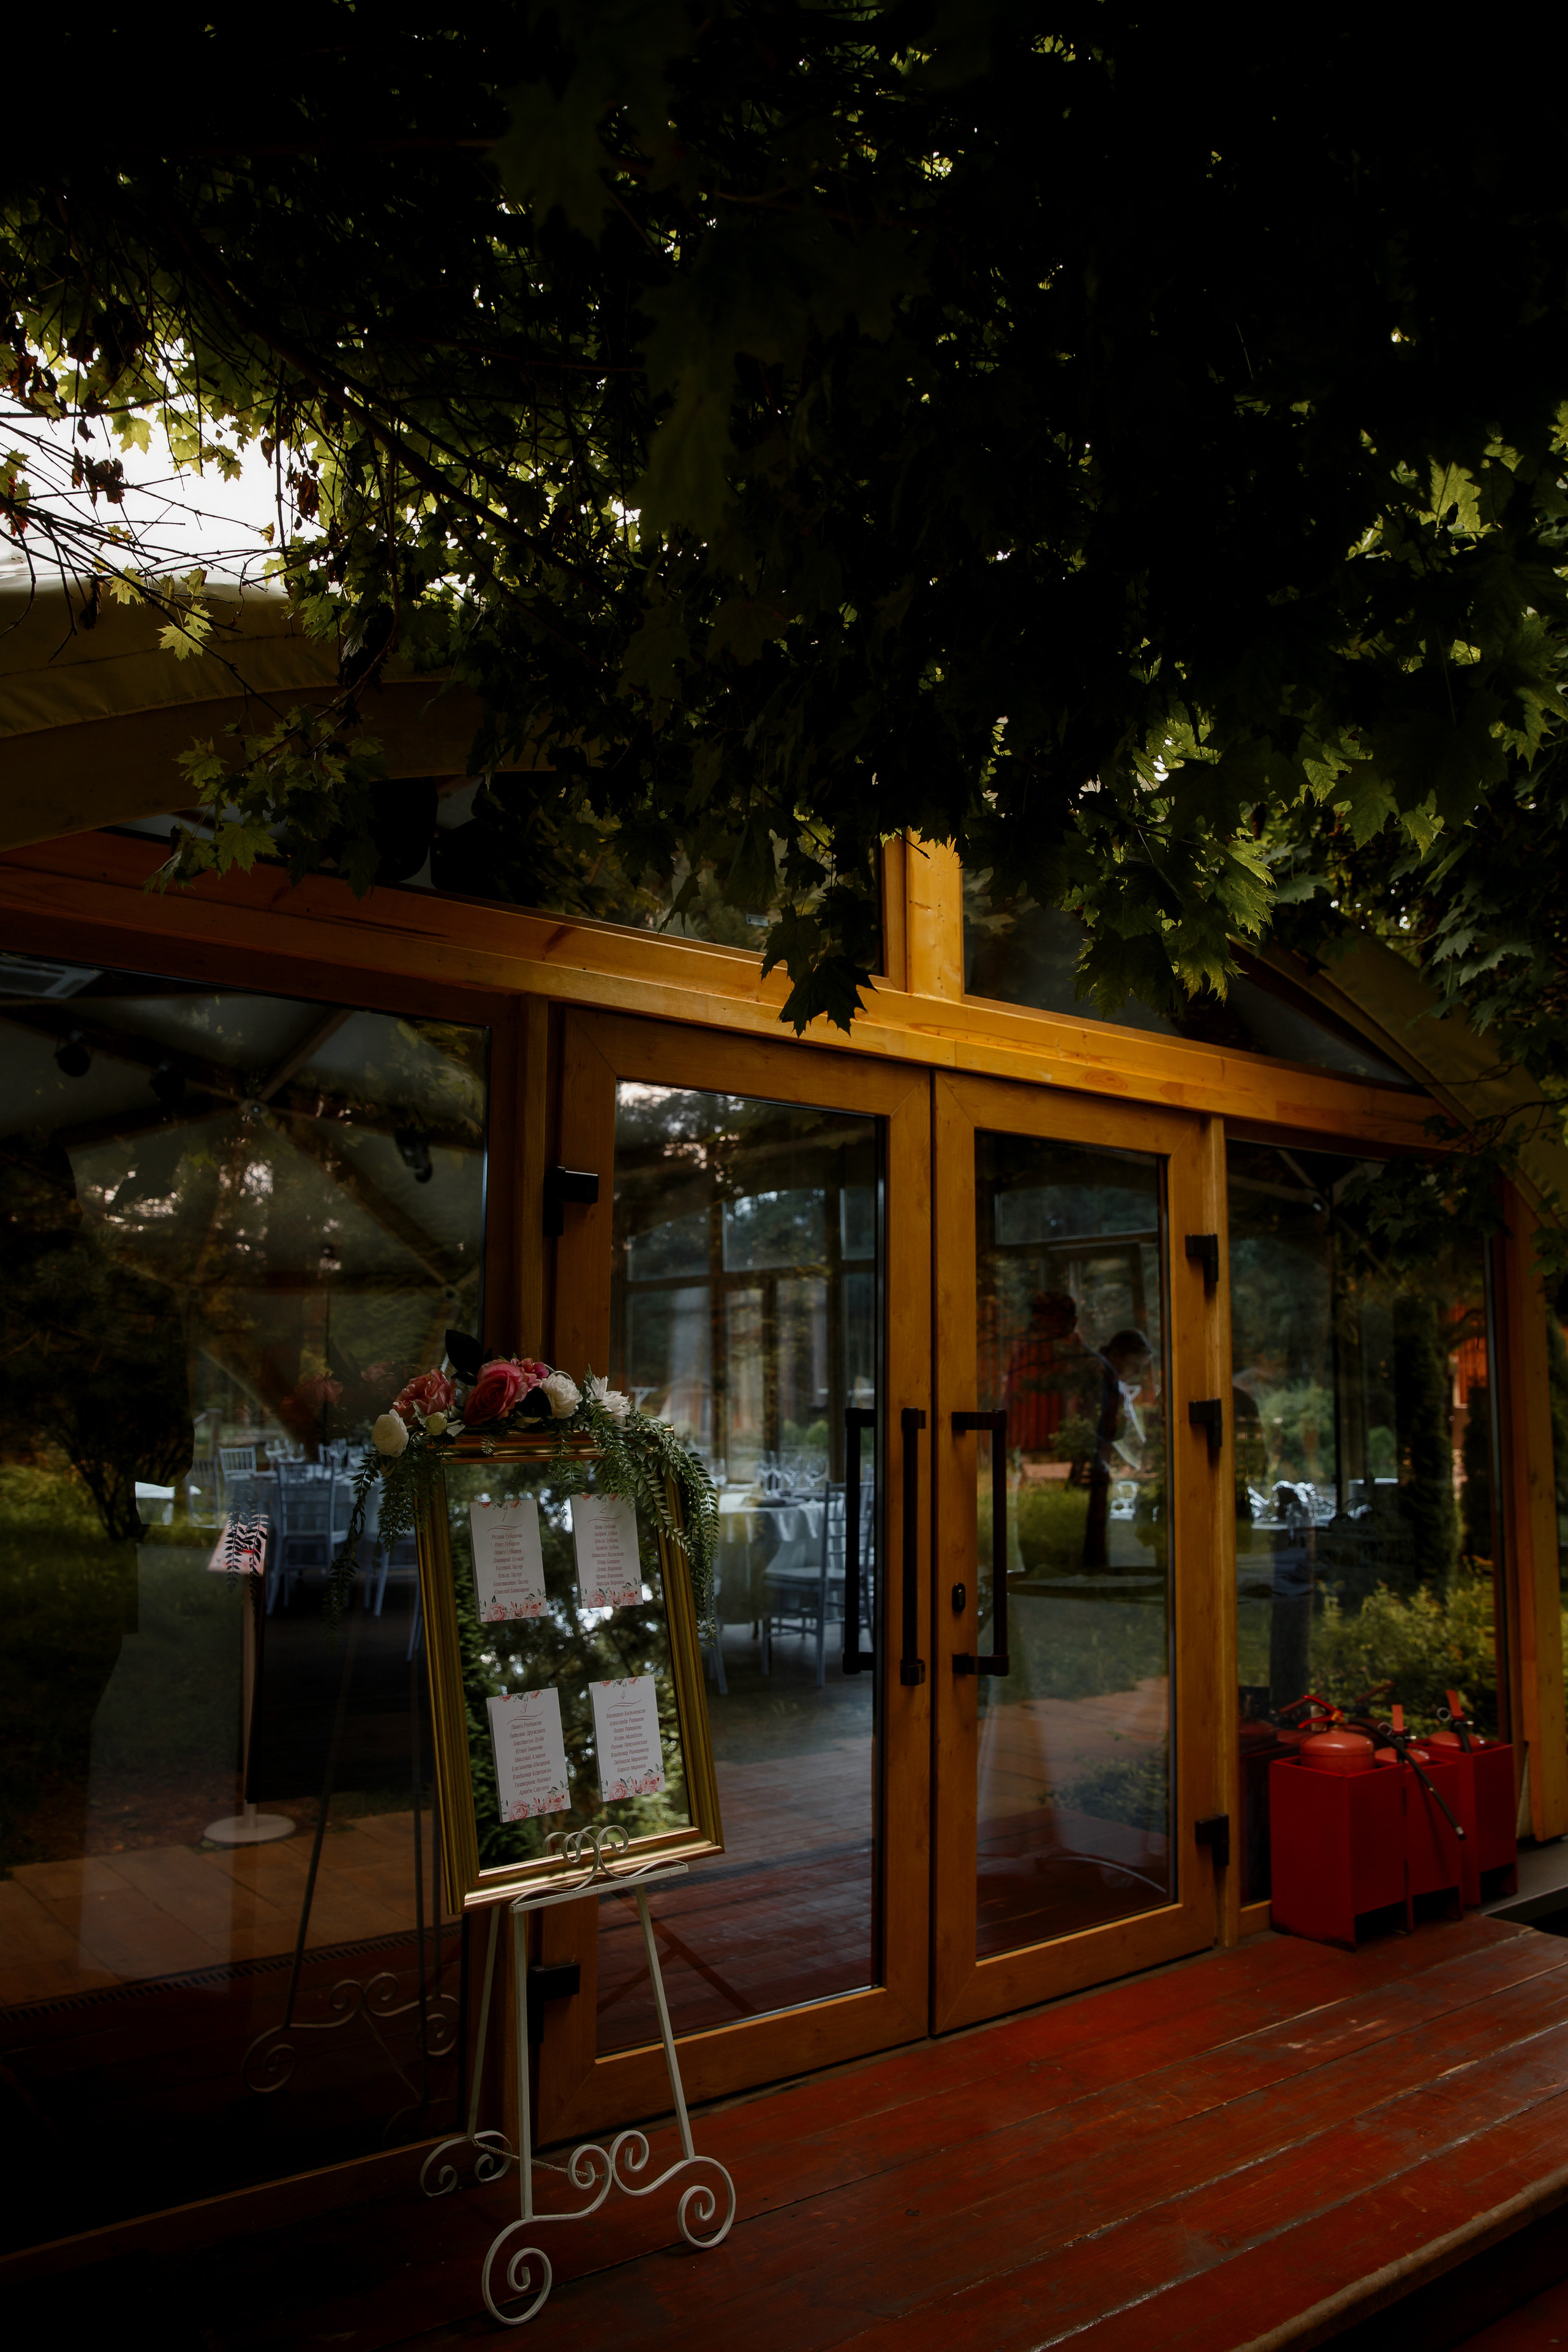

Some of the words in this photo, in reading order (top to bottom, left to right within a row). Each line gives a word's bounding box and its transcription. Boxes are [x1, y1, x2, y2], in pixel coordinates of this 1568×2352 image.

[600, 1504, 607, 1513] 2
[620, 1691, 626, 1700] 4
[521, 1703, 527, 1714] 3
